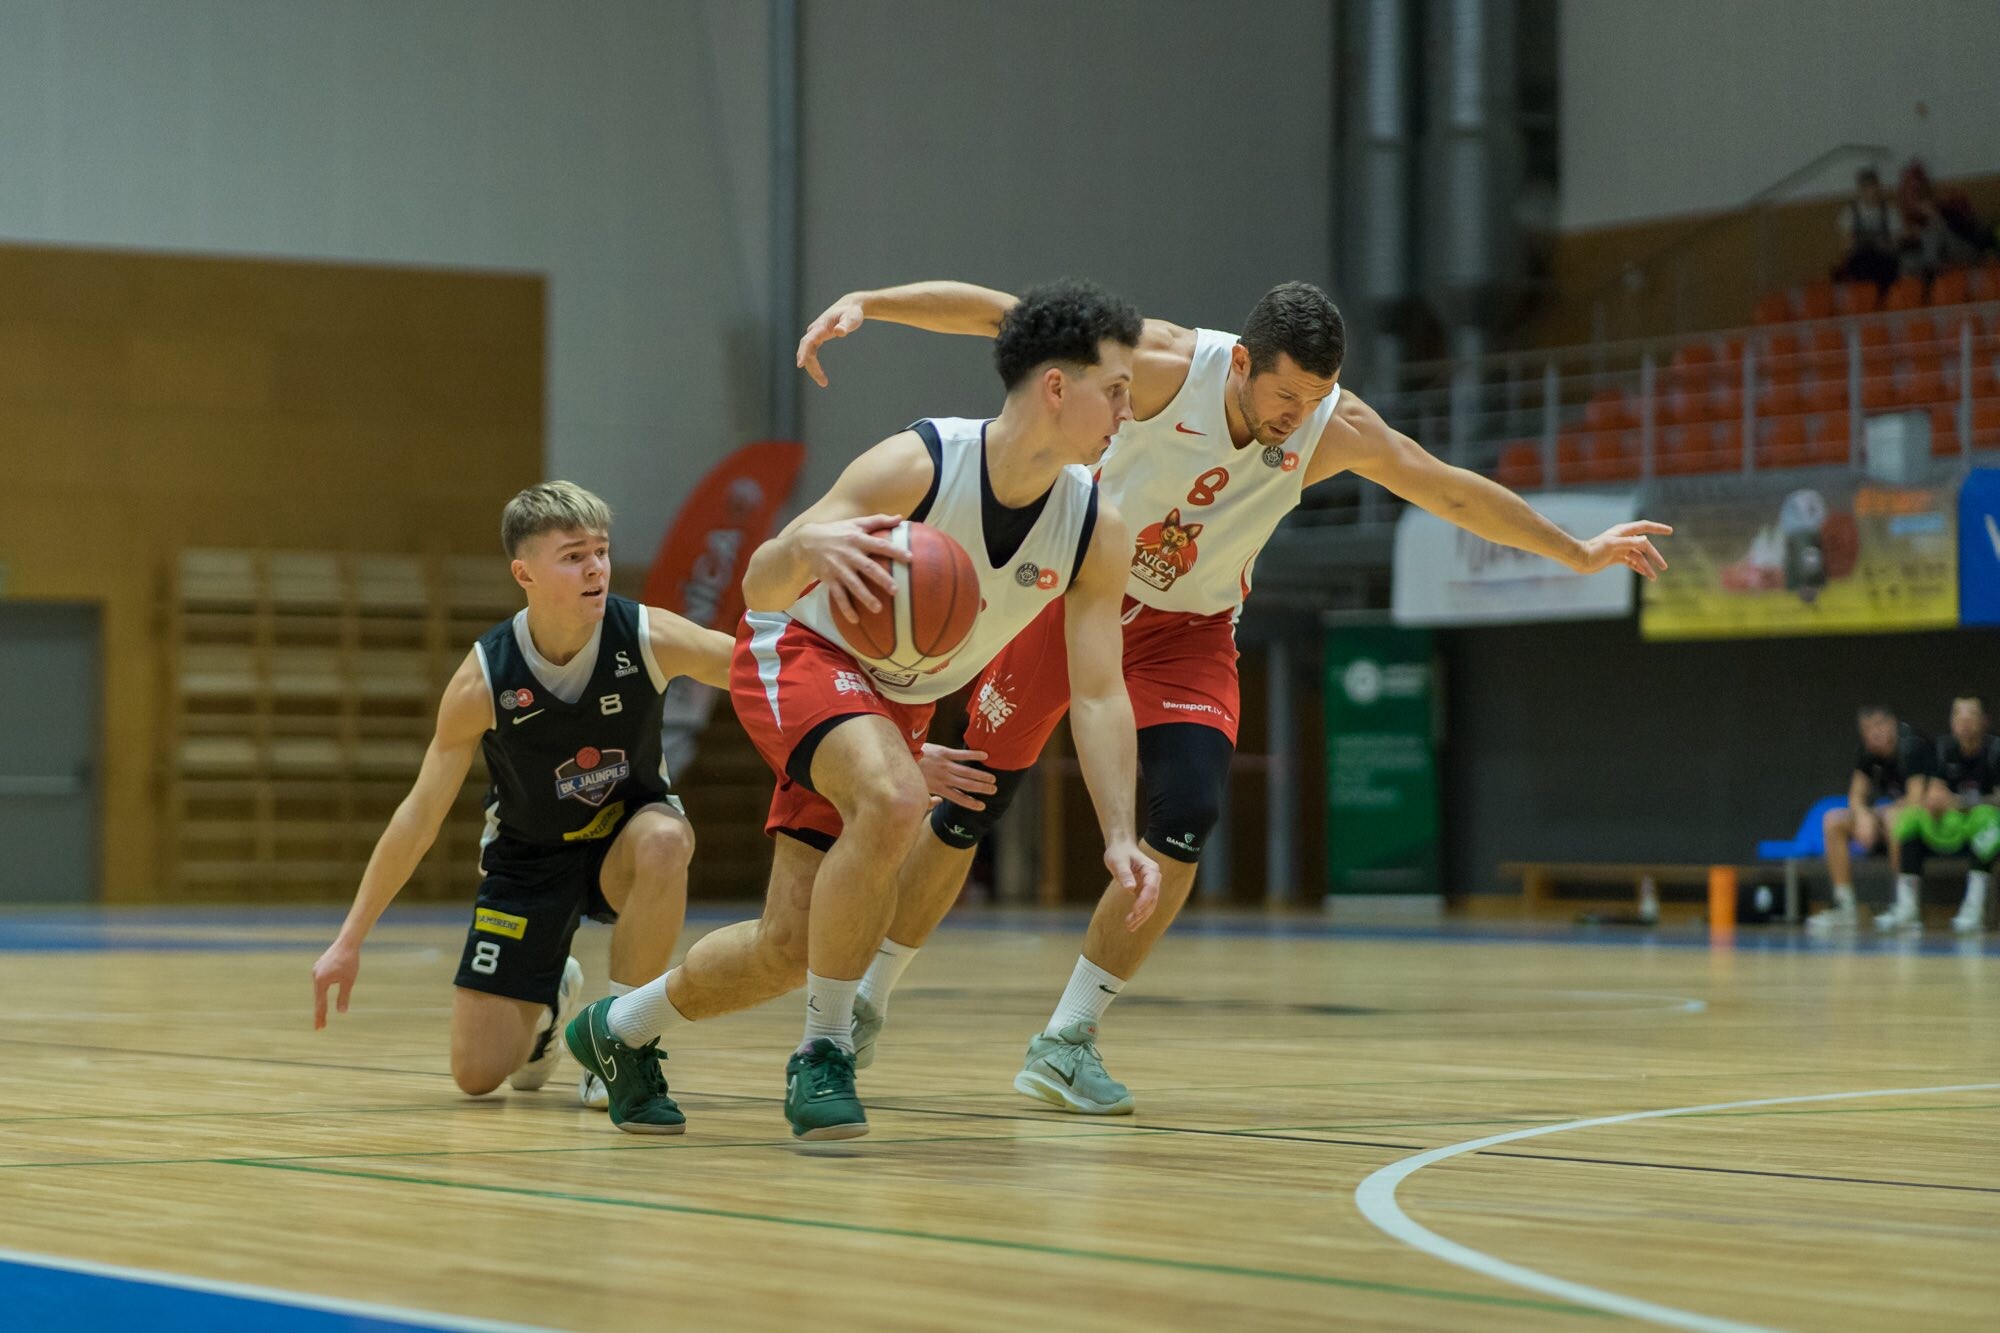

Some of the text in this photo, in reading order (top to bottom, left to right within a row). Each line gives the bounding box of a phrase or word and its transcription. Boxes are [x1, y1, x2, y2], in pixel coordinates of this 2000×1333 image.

[1187, 467, 1230, 506] 8
[600, 694, 623, 715] 8
[560, 779, 577, 794] BK
[579, 765, 627, 788] JAUNPILS
[471, 941, 501, 975] 8
